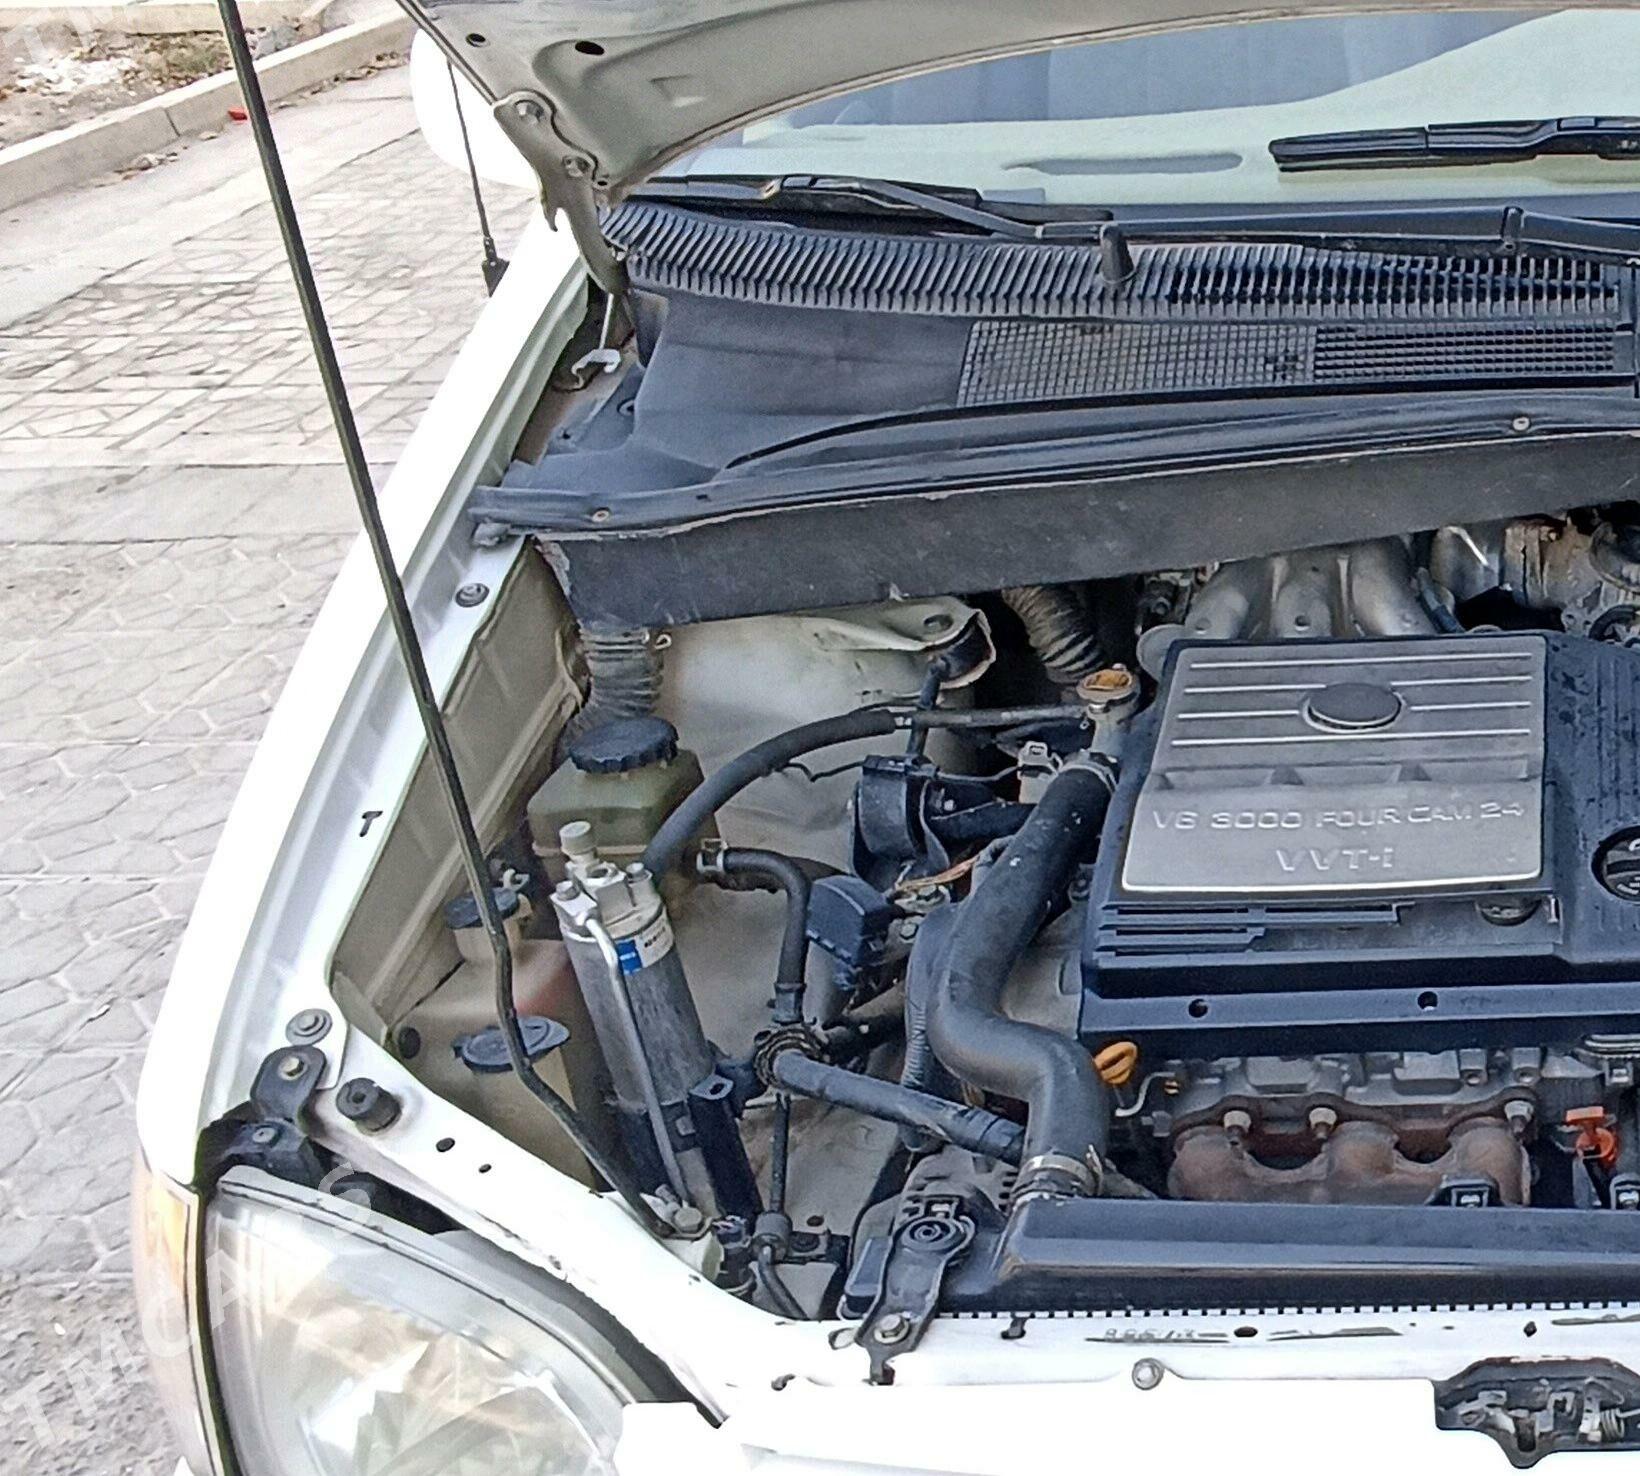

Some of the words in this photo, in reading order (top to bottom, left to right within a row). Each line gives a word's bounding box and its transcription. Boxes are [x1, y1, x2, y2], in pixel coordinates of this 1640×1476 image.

[1210, 811, 1303, 830] 3000
[1315, 807, 1401, 829] FOUR
[1407, 805, 1473, 824] CAM
